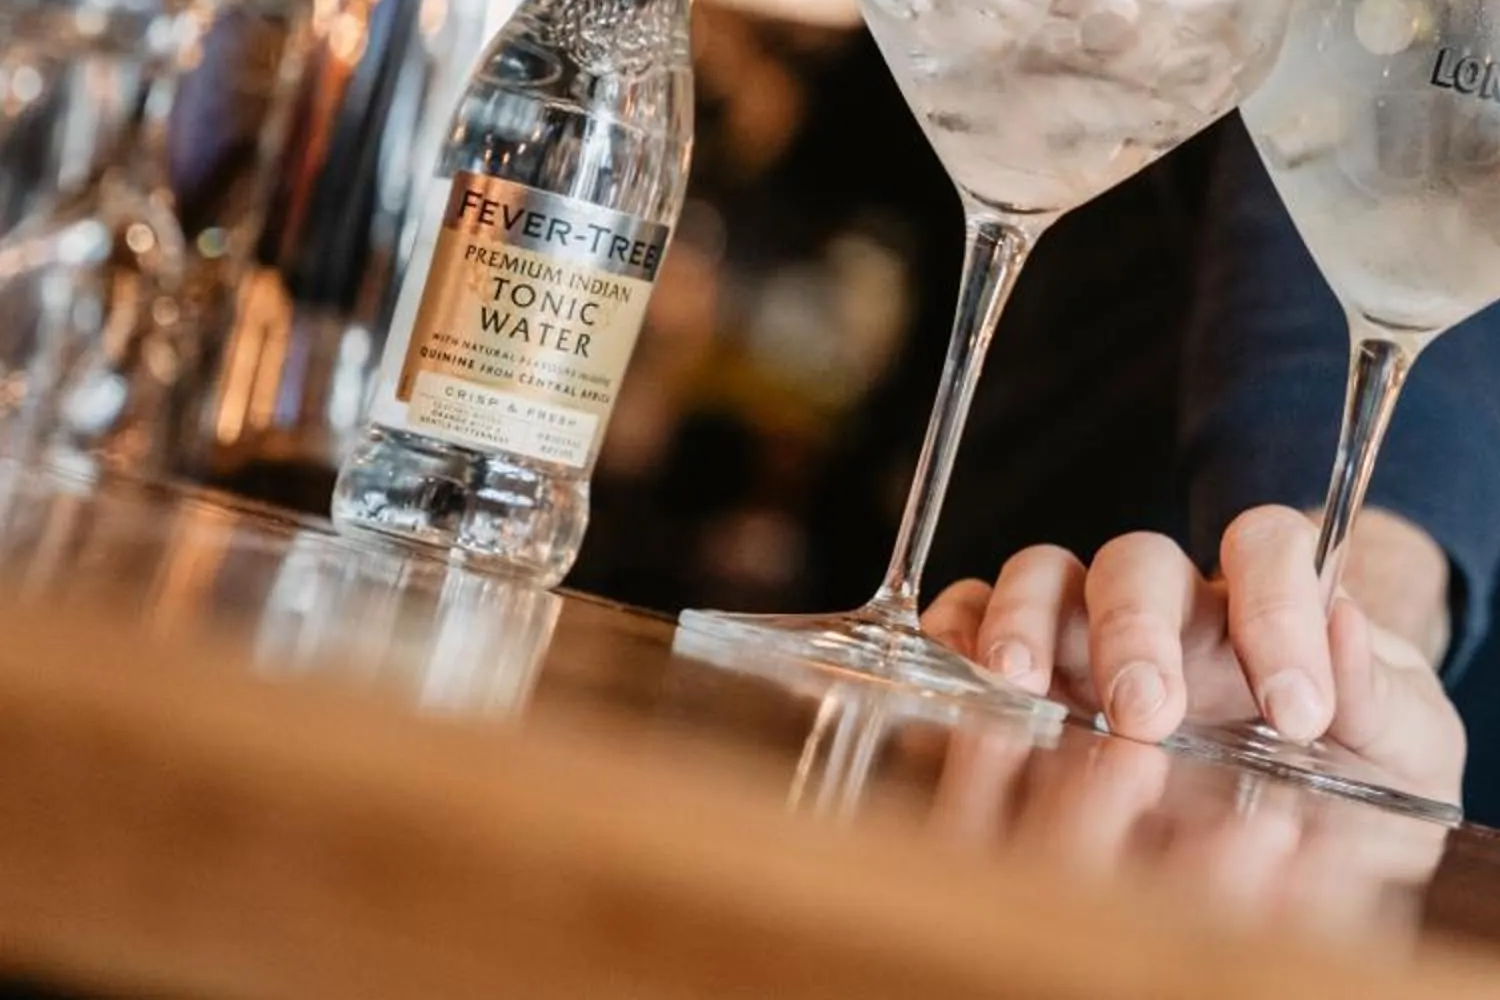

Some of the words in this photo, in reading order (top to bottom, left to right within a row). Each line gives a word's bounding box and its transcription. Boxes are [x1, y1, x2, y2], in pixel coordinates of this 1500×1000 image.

[458, 189, 658, 268] FEVER-TREE
[465, 244, 564, 281] PREMIUM
[569, 273, 632, 303] INDIAN
[492, 277, 600, 327] TONIC
[461, 339, 516, 363] NATURAL
[480, 307, 592, 358] WATER
[420, 346, 476, 370] QUININE
[480, 363, 514, 379] FROM
[519, 373, 577, 398] CENTRAL
[444, 386, 499, 408] CRISP
[507, 402, 518, 415] &
